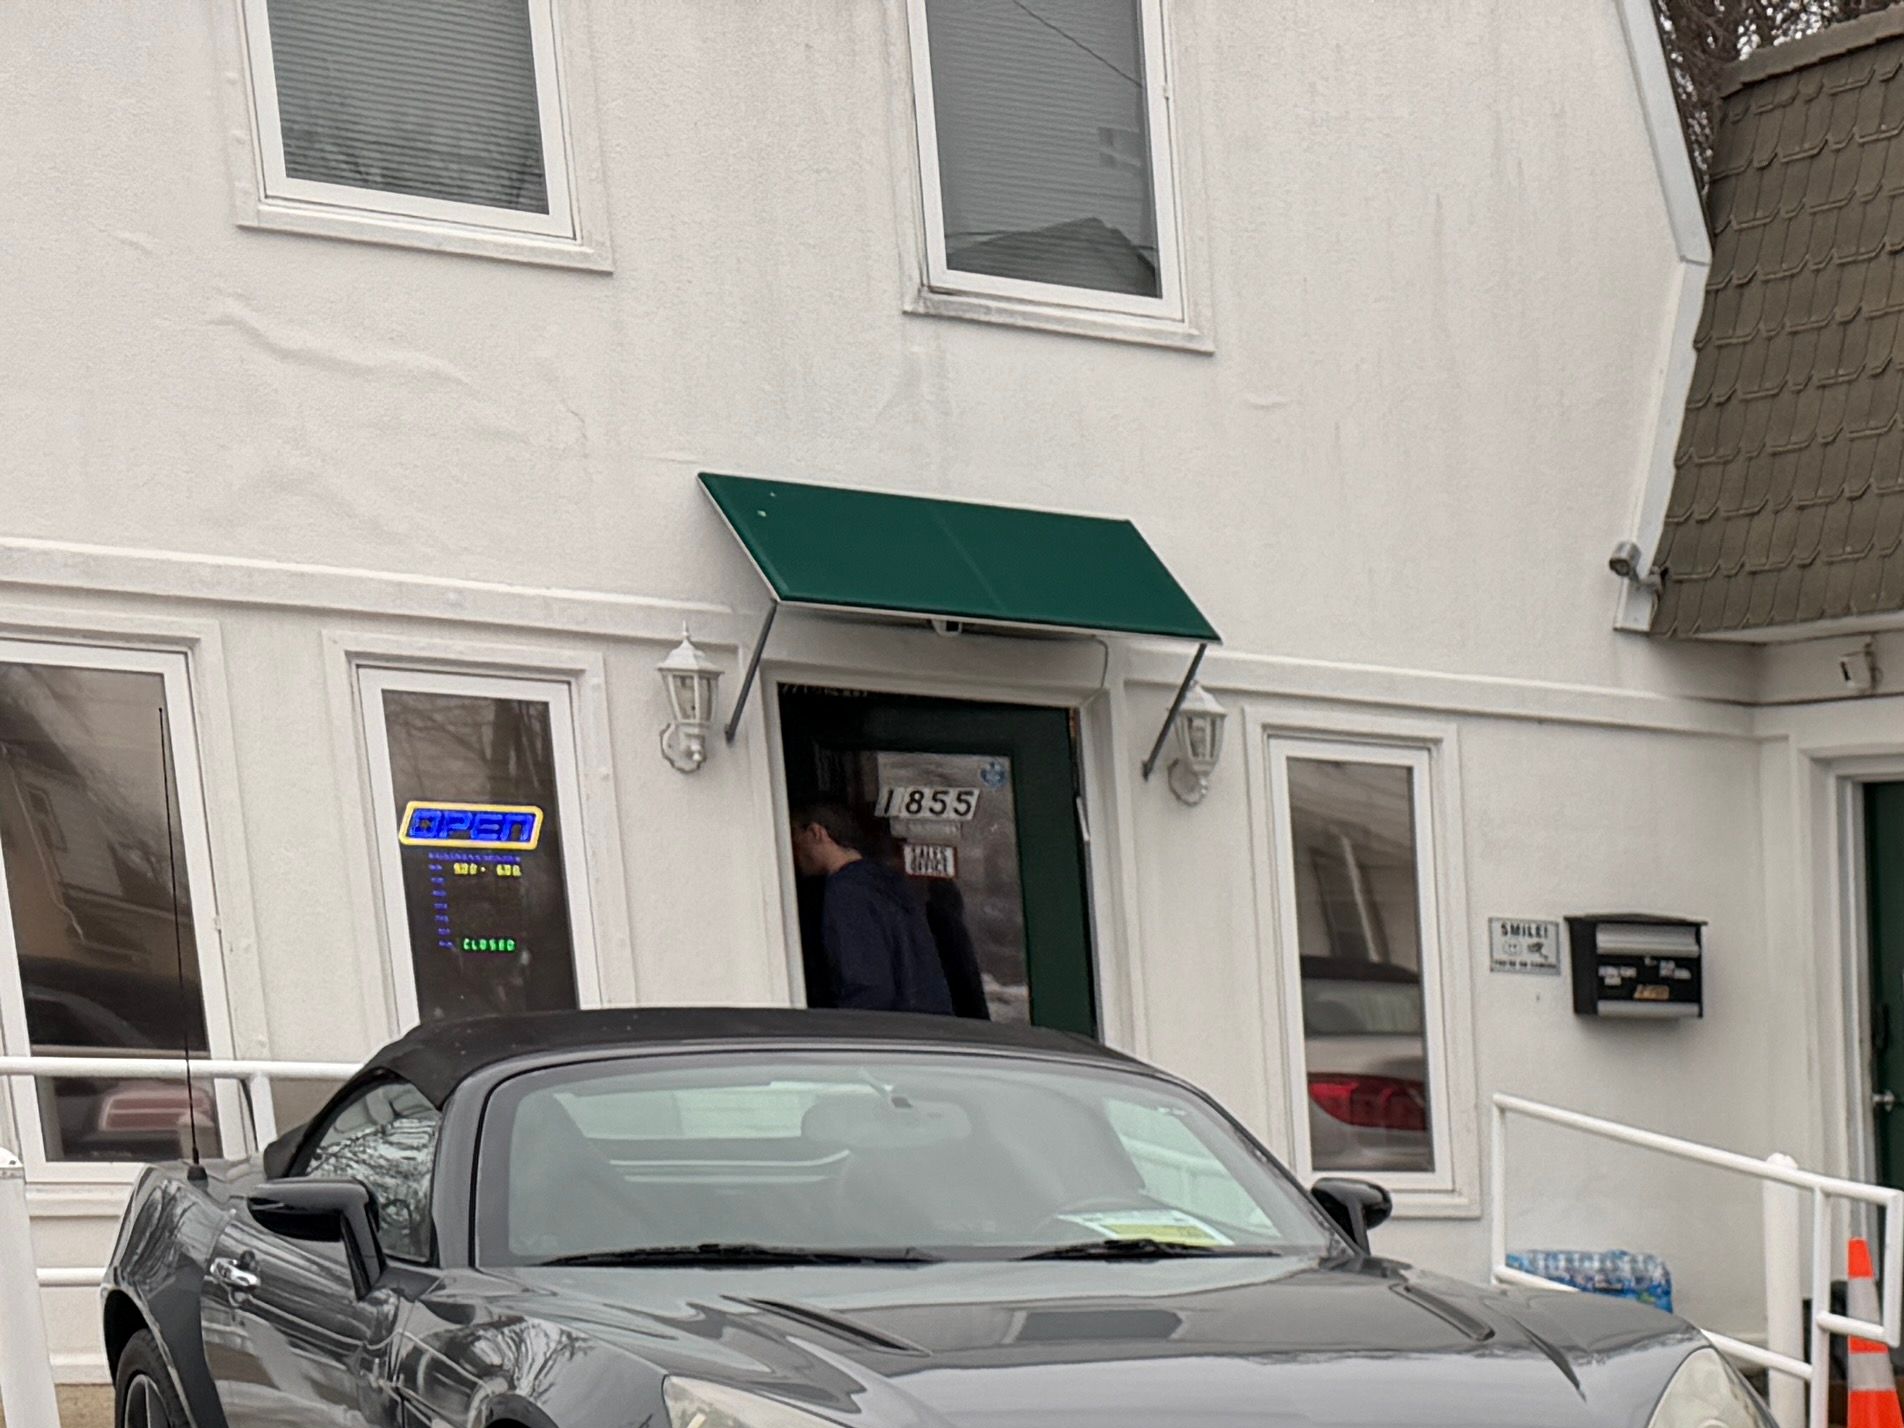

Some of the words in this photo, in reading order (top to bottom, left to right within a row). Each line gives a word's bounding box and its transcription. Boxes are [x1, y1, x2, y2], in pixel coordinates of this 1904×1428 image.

[883, 787, 974, 817] 1855
[408, 809, 534, 843] OPEN
[1501, 923, 1548, 939] SMILE!
[463, 937, 516, 952] CLOSED
